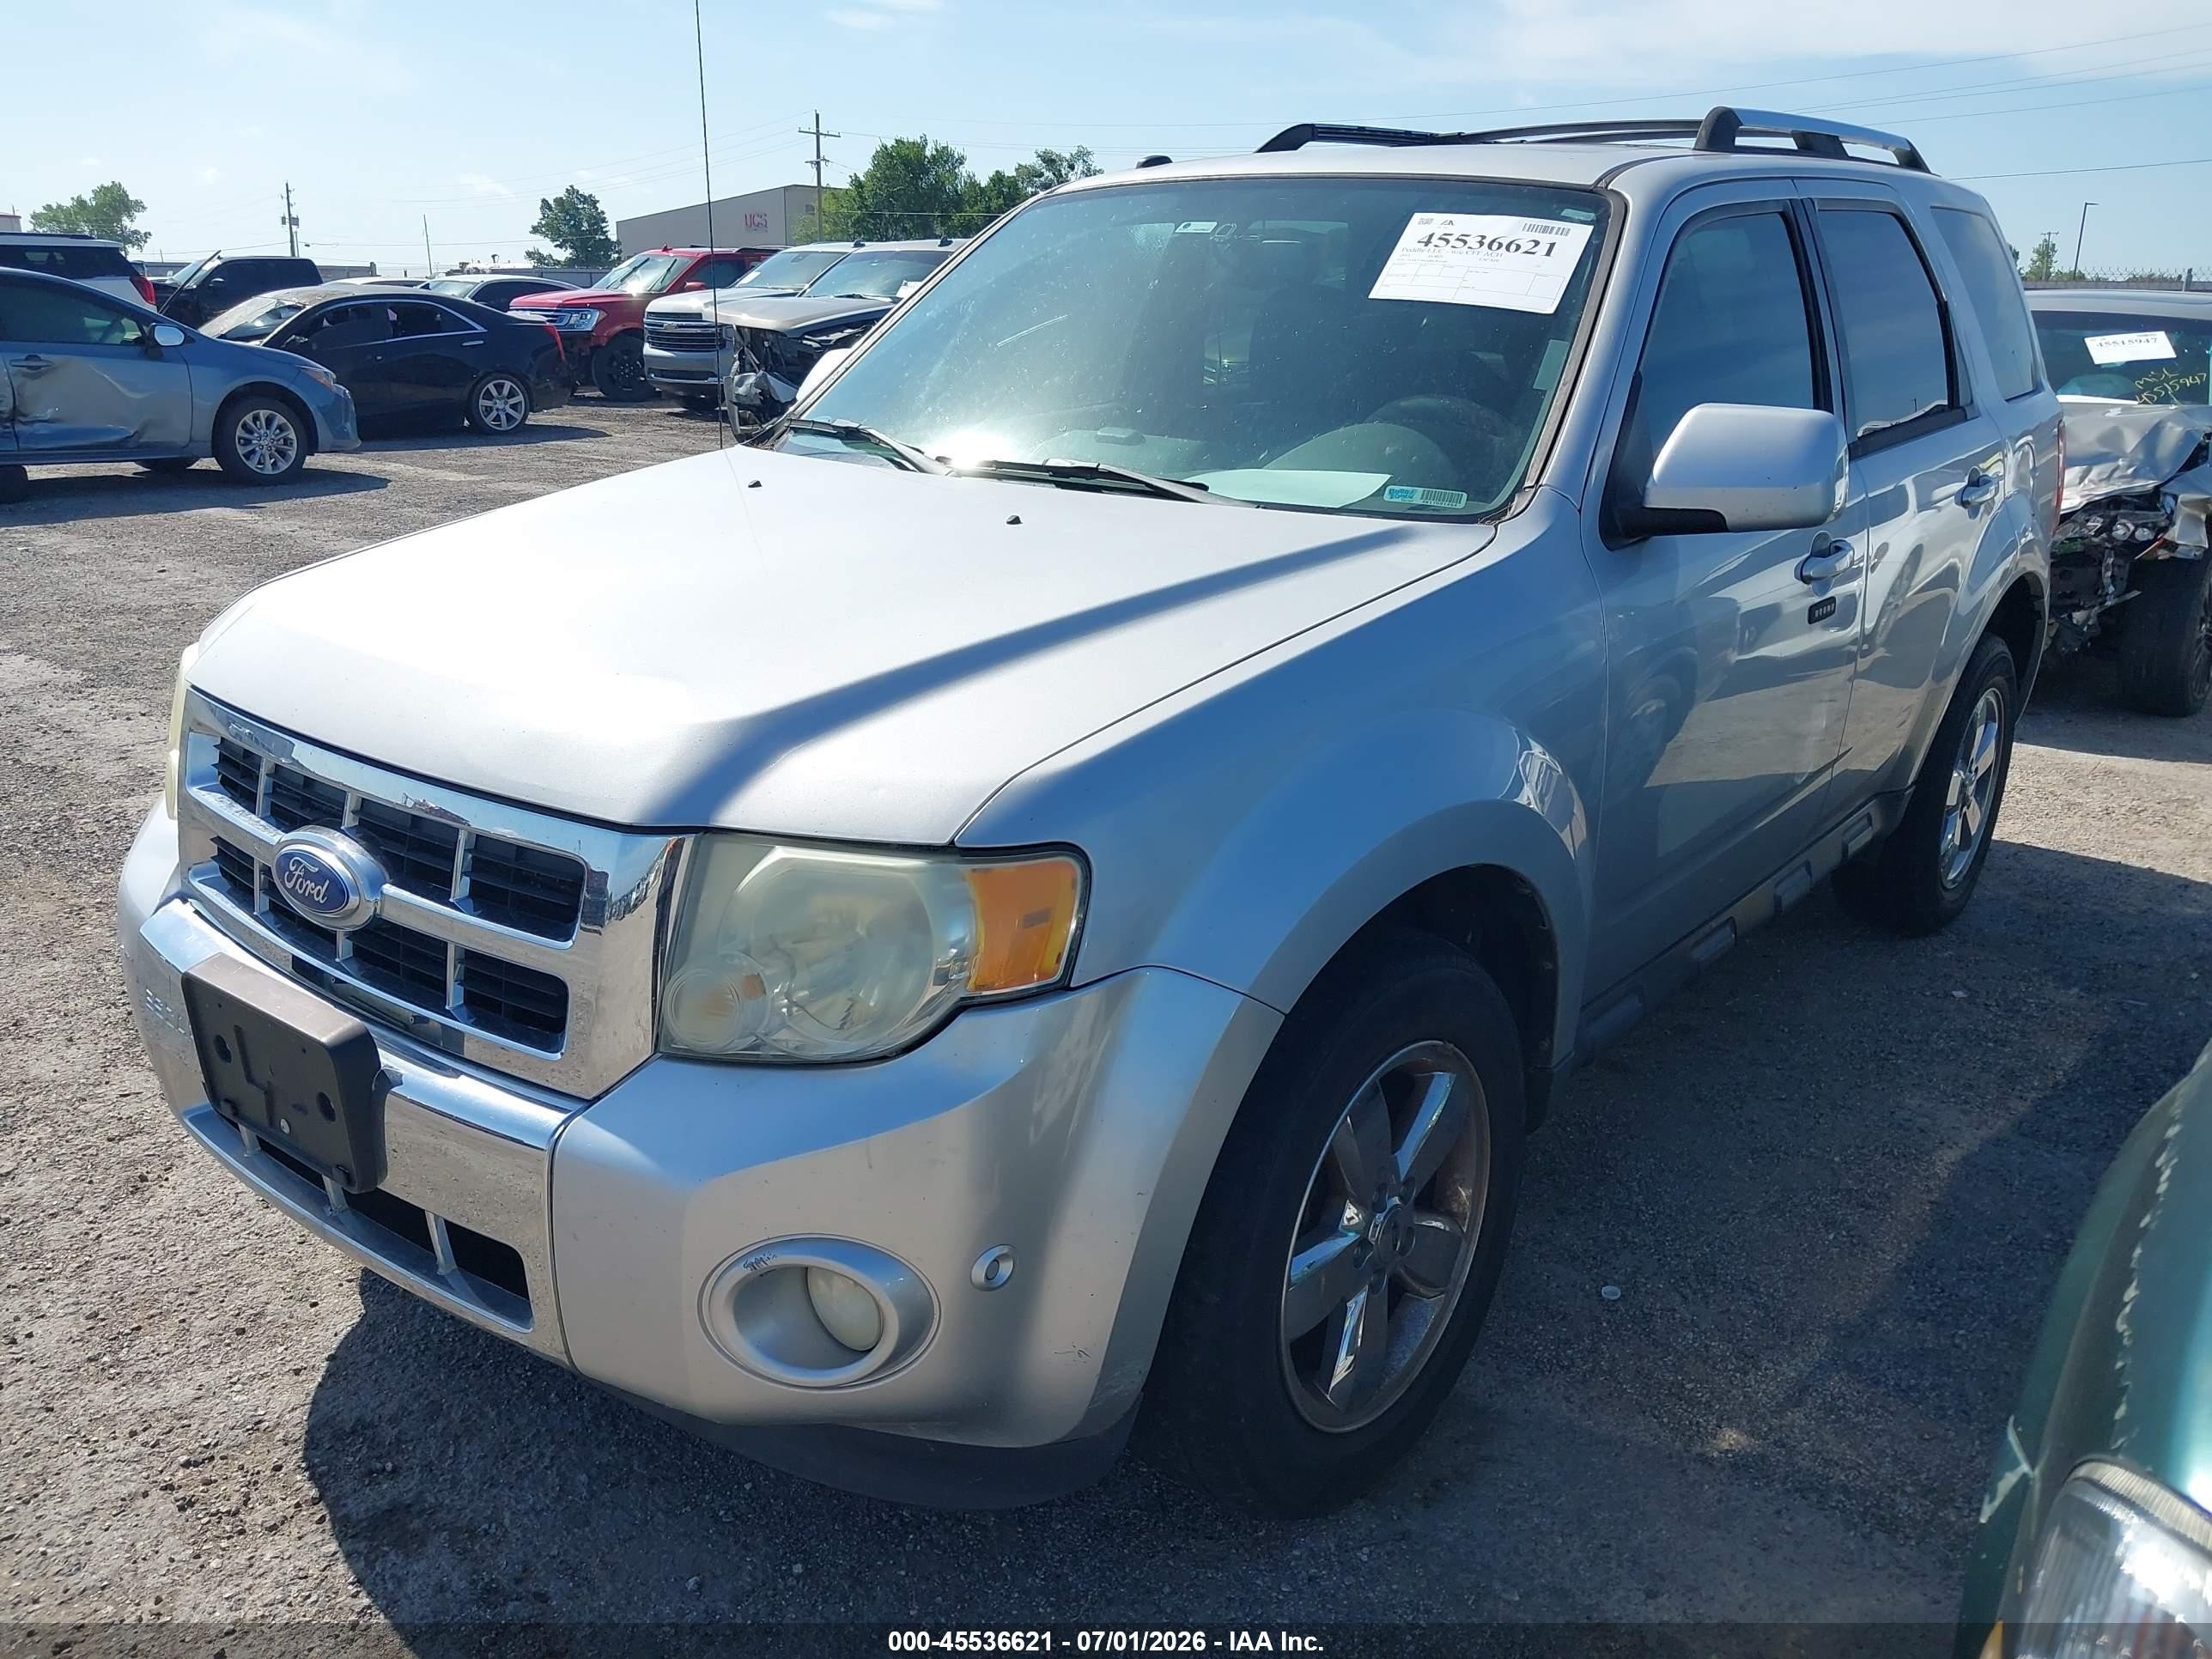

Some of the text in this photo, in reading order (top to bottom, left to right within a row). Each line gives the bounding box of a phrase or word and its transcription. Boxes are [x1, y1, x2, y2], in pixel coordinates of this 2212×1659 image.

[1417, 232, 1557, 258] 45536621
[2096, 337, 2158, 347] 45515947
[2135, 373, 2207, 405] 45515947
[284, 856, 331, 904] Ford
